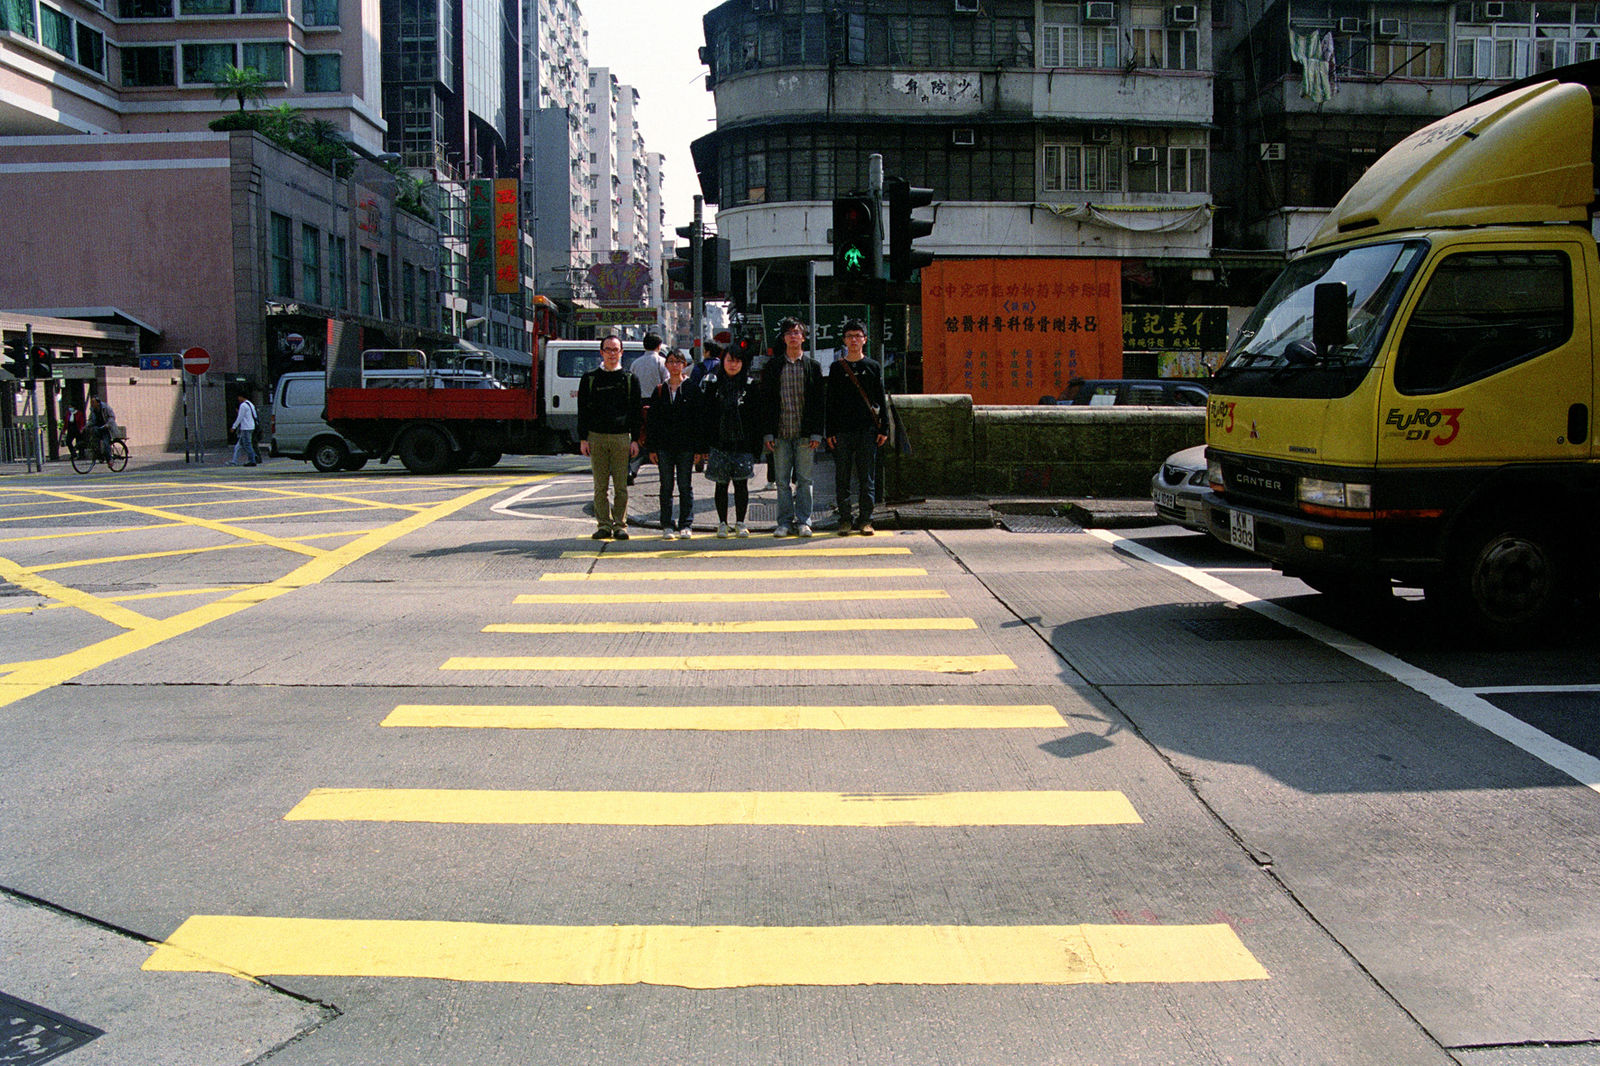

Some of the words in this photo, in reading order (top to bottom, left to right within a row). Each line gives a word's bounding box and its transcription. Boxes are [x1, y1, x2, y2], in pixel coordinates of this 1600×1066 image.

[495, 188, 518, 283] 西岸商場
[1385, 408, 1442, 431] EURO
[1433, 408, 1465, 447] 3
[1406, 430, 1431, 441] DI
[1236, 473, 1282, 490] CANTER
[1232, 526, 1253, 547] 5303
